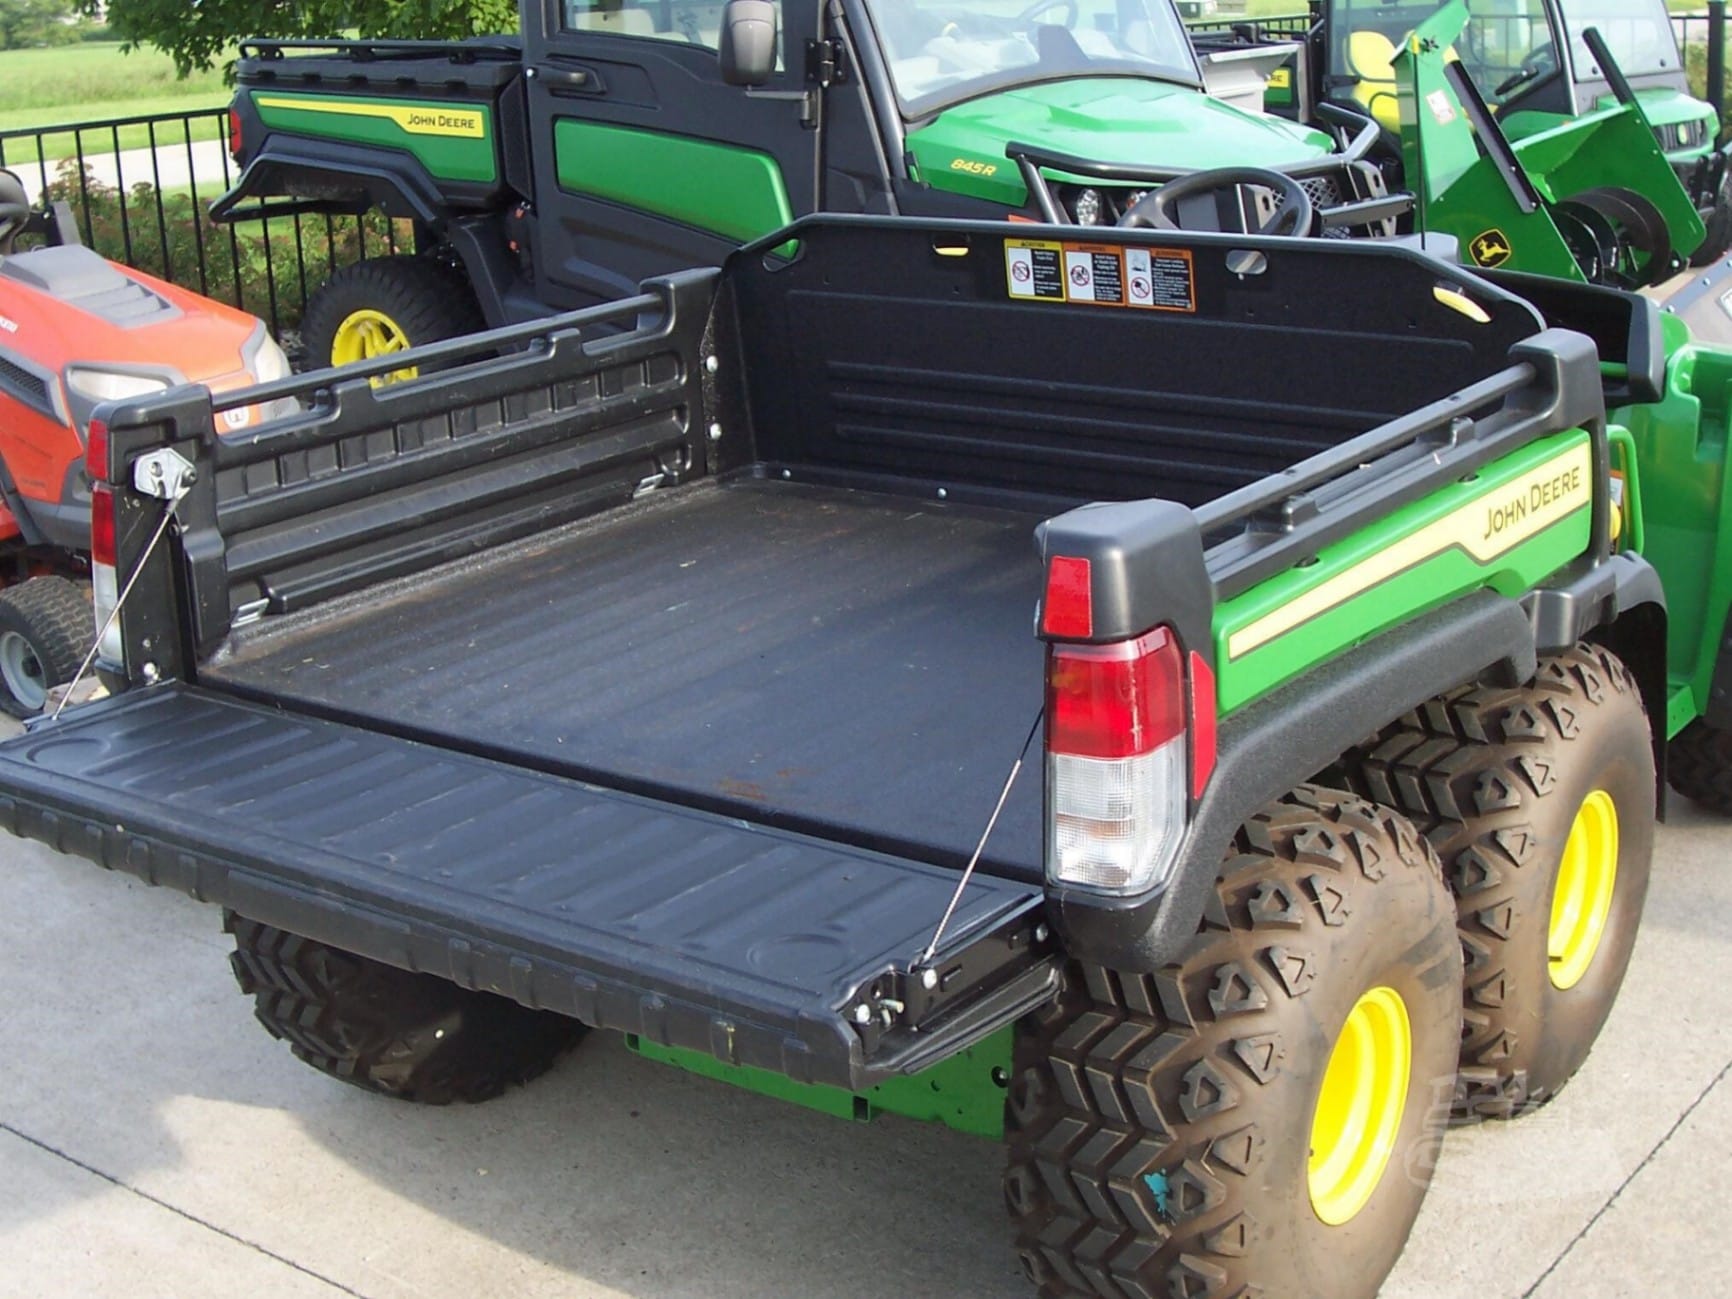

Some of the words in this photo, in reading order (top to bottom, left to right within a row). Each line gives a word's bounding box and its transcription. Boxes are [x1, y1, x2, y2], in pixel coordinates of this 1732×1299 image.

[408, 113, 436, 126] JOHN
[438, 115, 475, 129] DEERE
[950, 158, 997, 177] 845R
[1484, 495, 1526, 541] JOHN
[1530, 466, 1580, 513] DEERE
